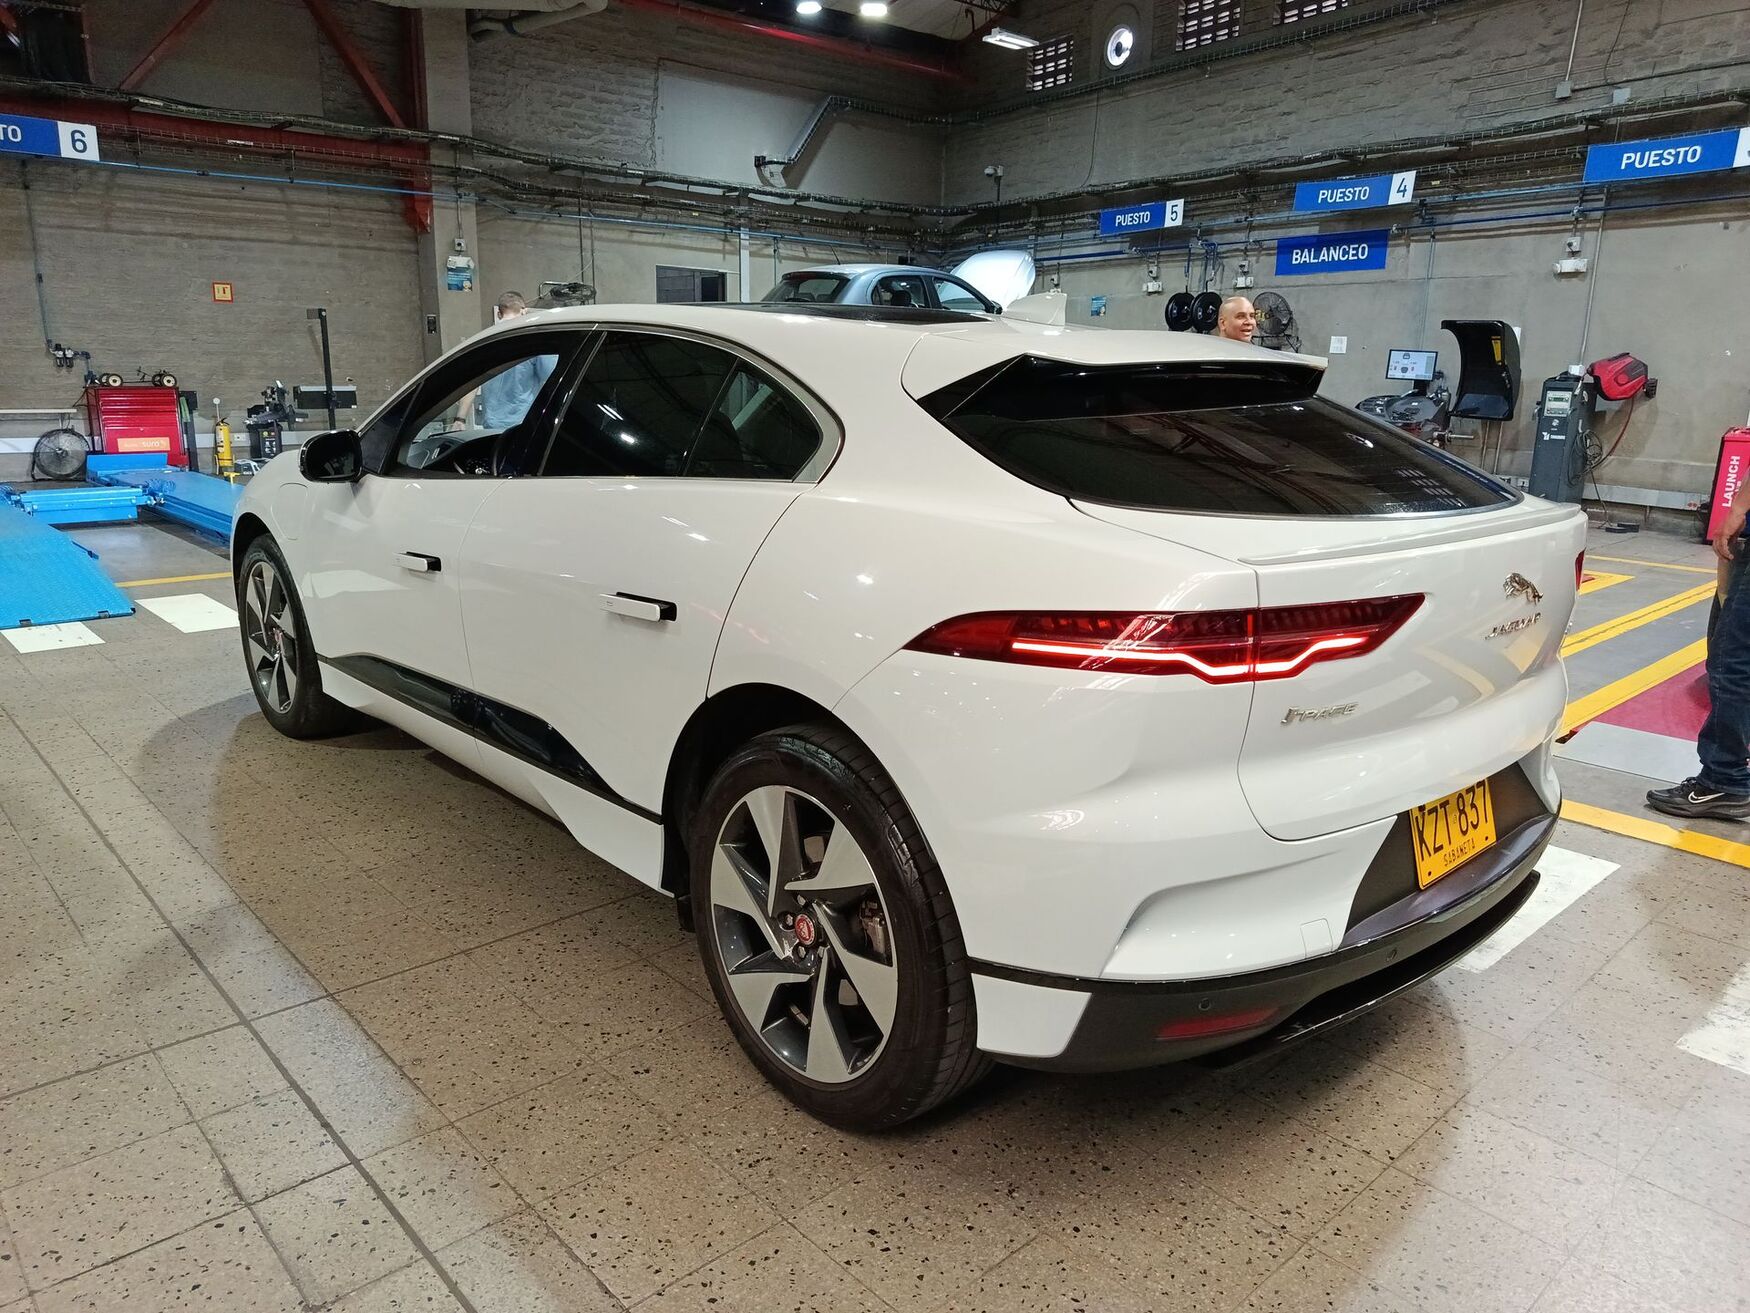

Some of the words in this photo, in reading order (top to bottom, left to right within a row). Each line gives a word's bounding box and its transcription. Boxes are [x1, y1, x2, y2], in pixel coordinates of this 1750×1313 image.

[70, 129, 88, 154] 6
[1620, 145, 1702, 170] PUESTO
[1317, 186, 1370, 204] PUESTO
[1396, 177, 1408, 199] 4
[1114, 211, 1151, 228] PUESTO
[1169, 204, 1179, 222] 5
[1291, 243, 1369, 265] BALANCEO
[1722, 455, 1741, 508] LAUNCH
[1415, 799, 1452, 862] KZT
[1456, 779, 1489, 837] 837
[1443, 837, 1477, 867] SABANETA
